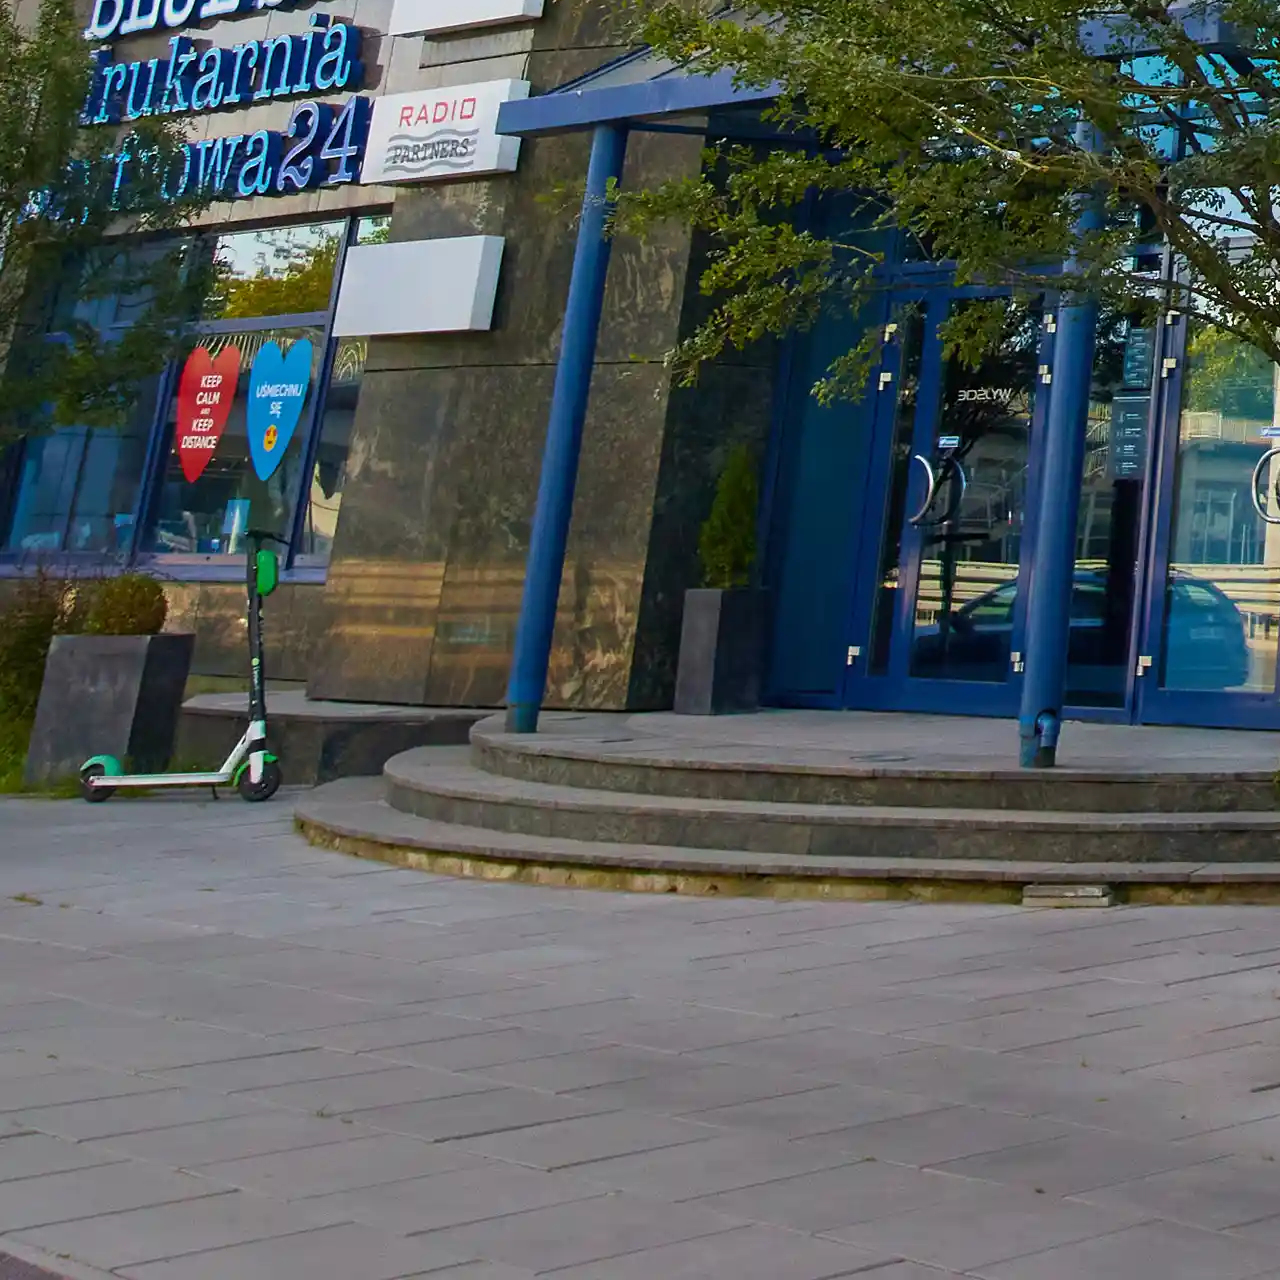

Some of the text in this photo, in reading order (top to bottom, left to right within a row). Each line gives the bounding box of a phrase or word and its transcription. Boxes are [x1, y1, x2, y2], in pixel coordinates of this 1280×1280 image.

[398, 97, 477, 127] RADIO
[391, 137, 471, 164] PARTNERS
[200, 374, 222, 388] KEEP
[196, 391, 220, 405] CALM
[191, 418, 214, 432] KEEP
[181, 435, 218, 449] DISTANCE
